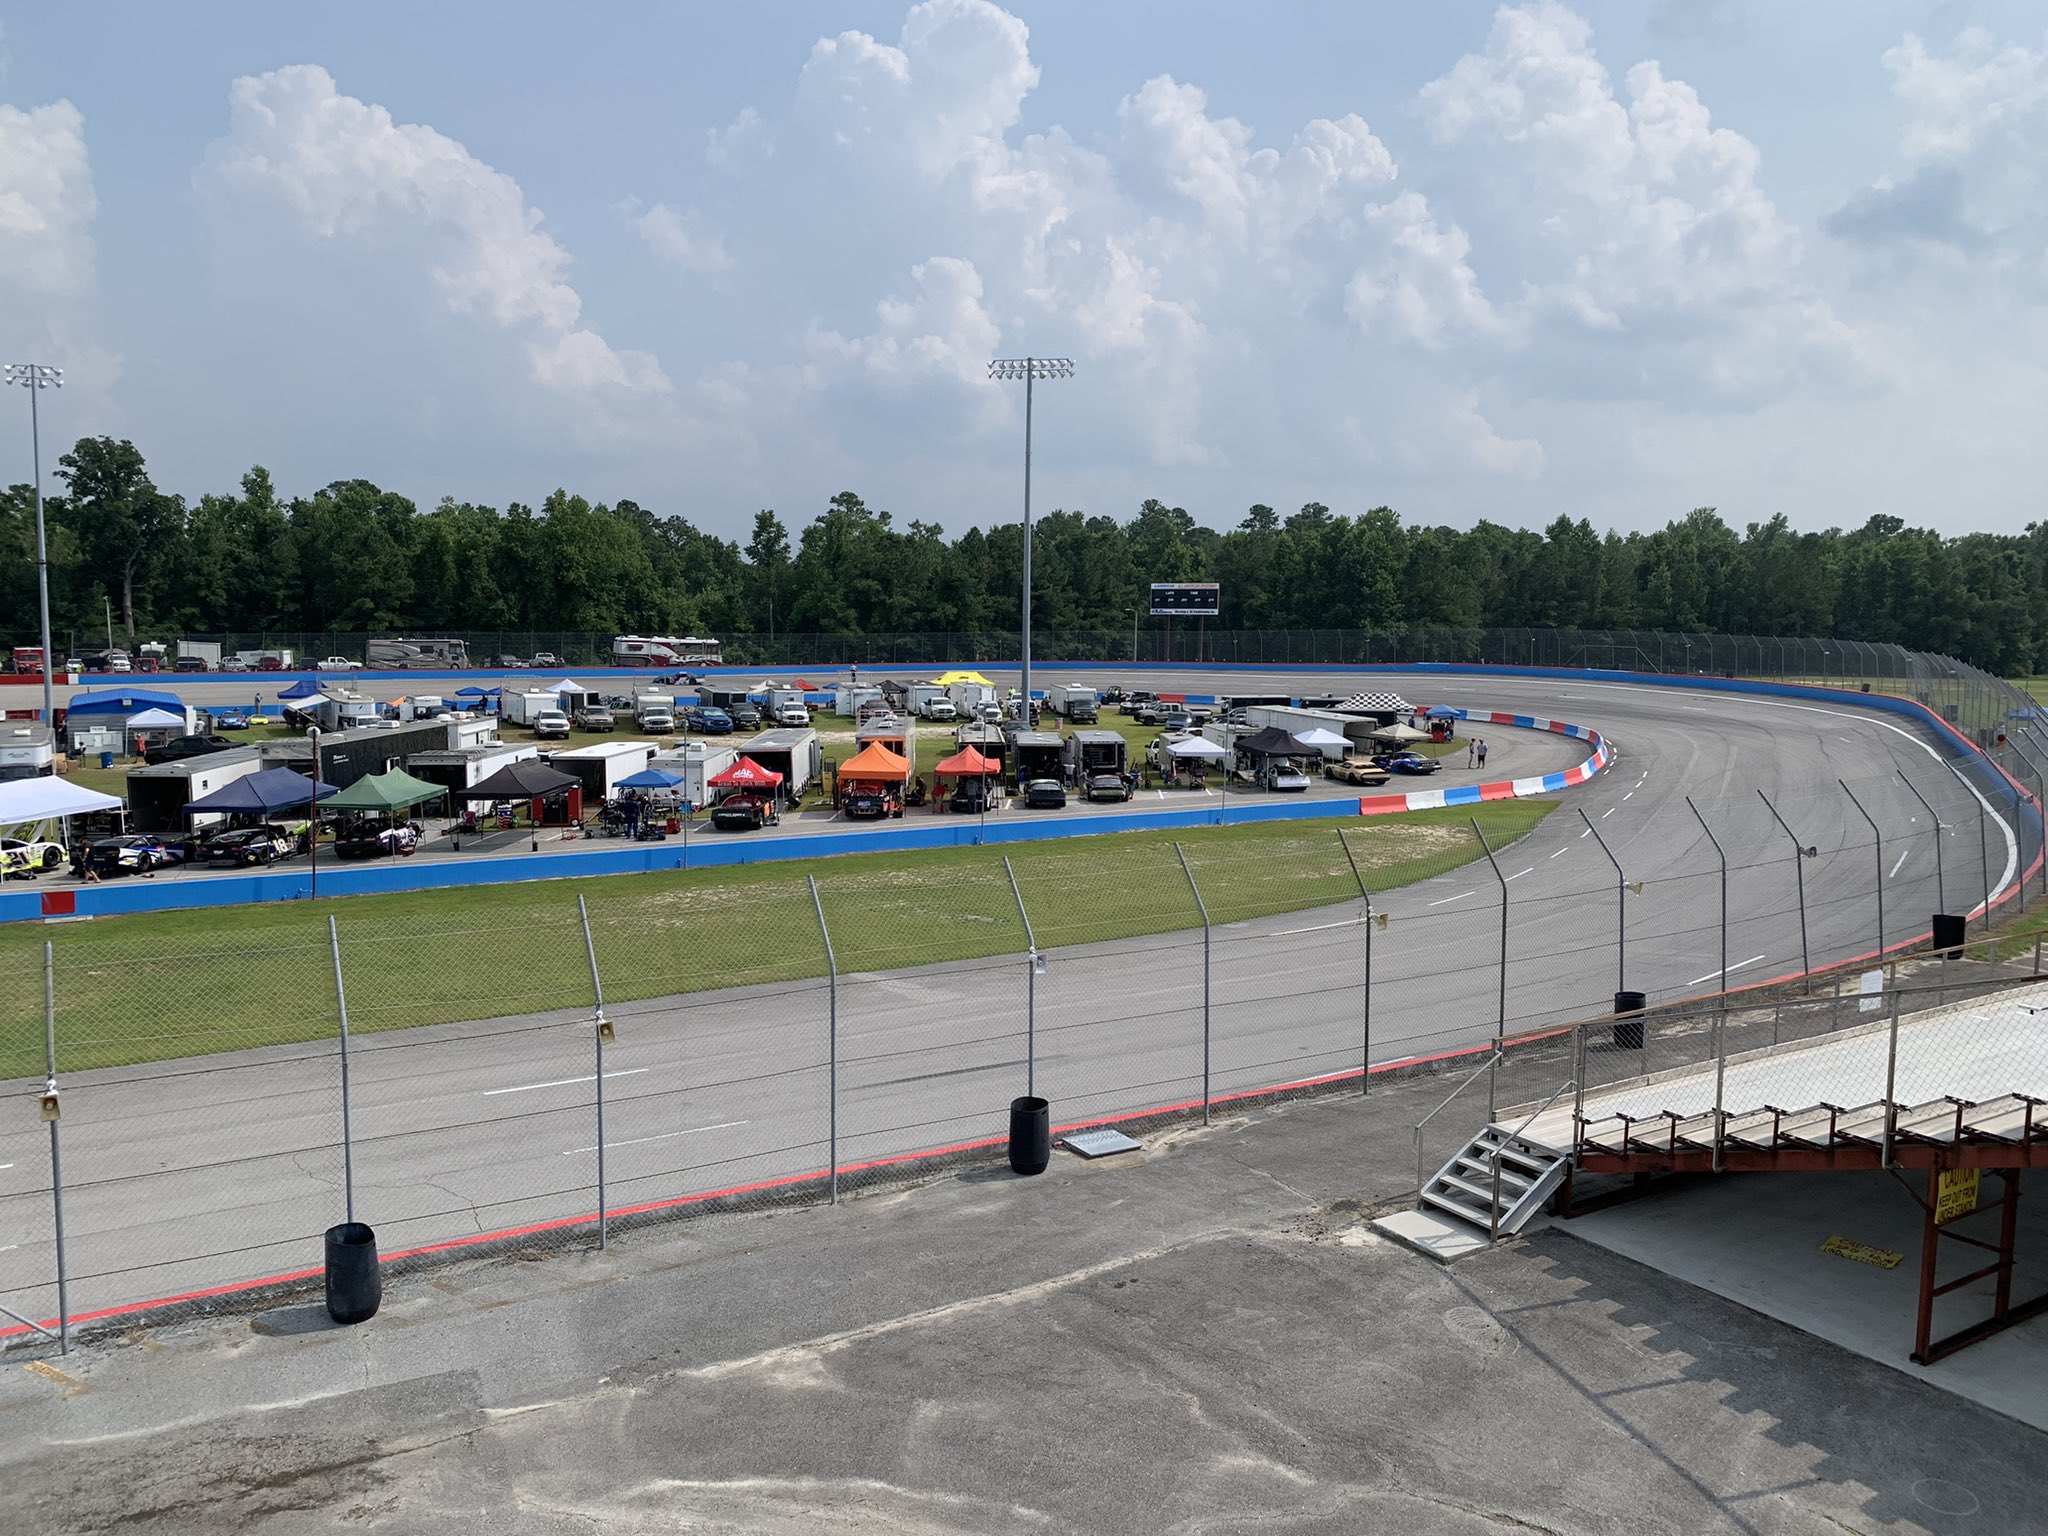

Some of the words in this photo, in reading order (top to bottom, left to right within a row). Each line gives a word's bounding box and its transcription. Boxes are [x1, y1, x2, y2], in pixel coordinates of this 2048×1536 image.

[273, 838, 288, 853] 18
[6, 851, 32, 866] 21
[1945, 1167, 1974, 1188] CAUTION
[1939, 1193, 1952, 1207] KEEP
[1952, 1190, 1963, 1203] OUT
[1963, 1185, 1976, 1200] FROM
[1937, 1206, 1955, 1222] UNDER
